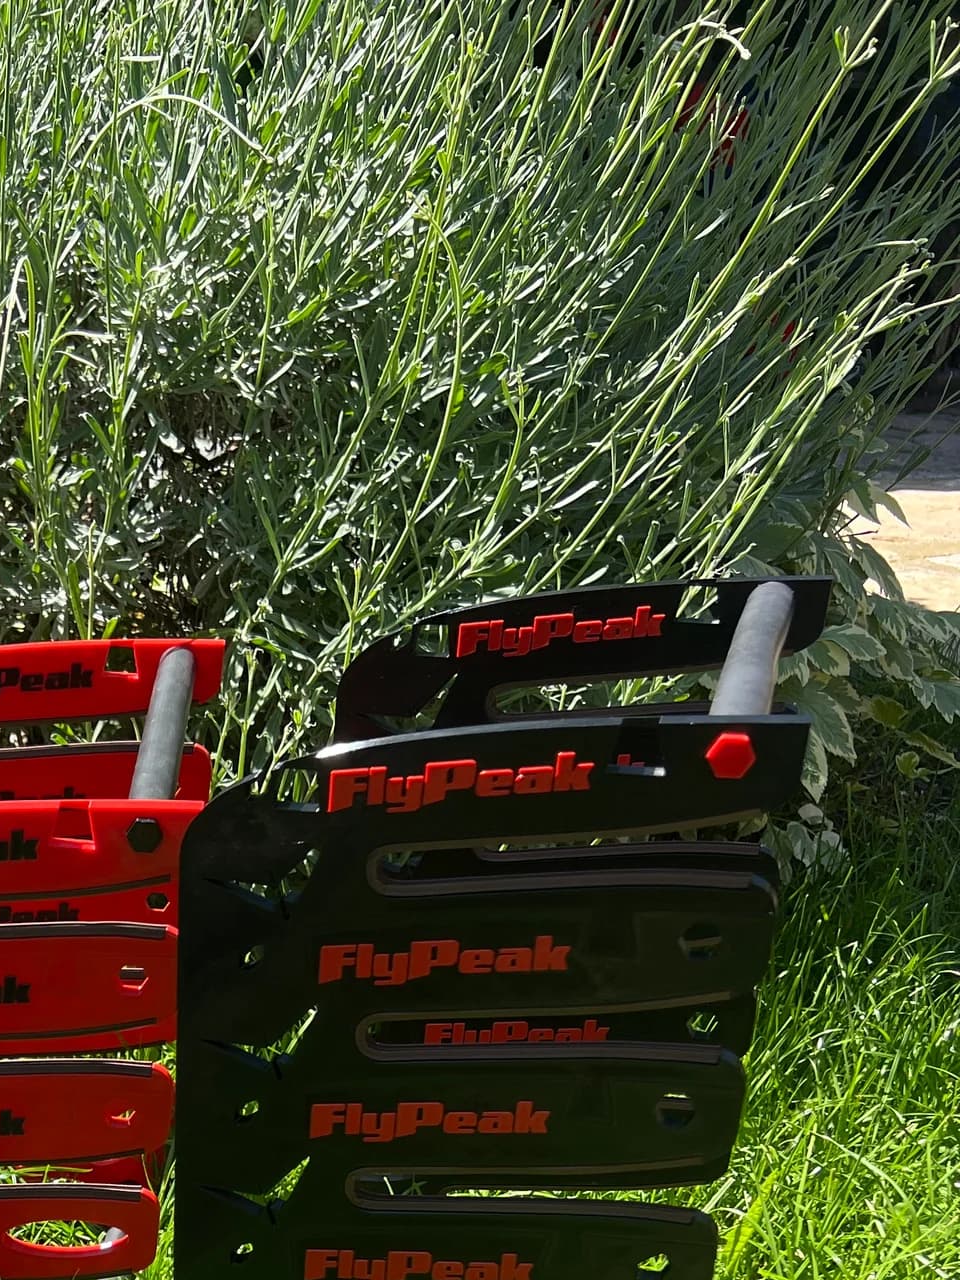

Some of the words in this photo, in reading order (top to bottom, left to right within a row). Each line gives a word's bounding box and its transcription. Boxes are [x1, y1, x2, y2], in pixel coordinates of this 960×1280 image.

[456, 606, 667, 659] FlyPeak
[326, 750, 596, 814] FlyPeak
[318, 935, 571, 986] FlyPeak
[308, 1100, 551, 1143] FlyPeak
